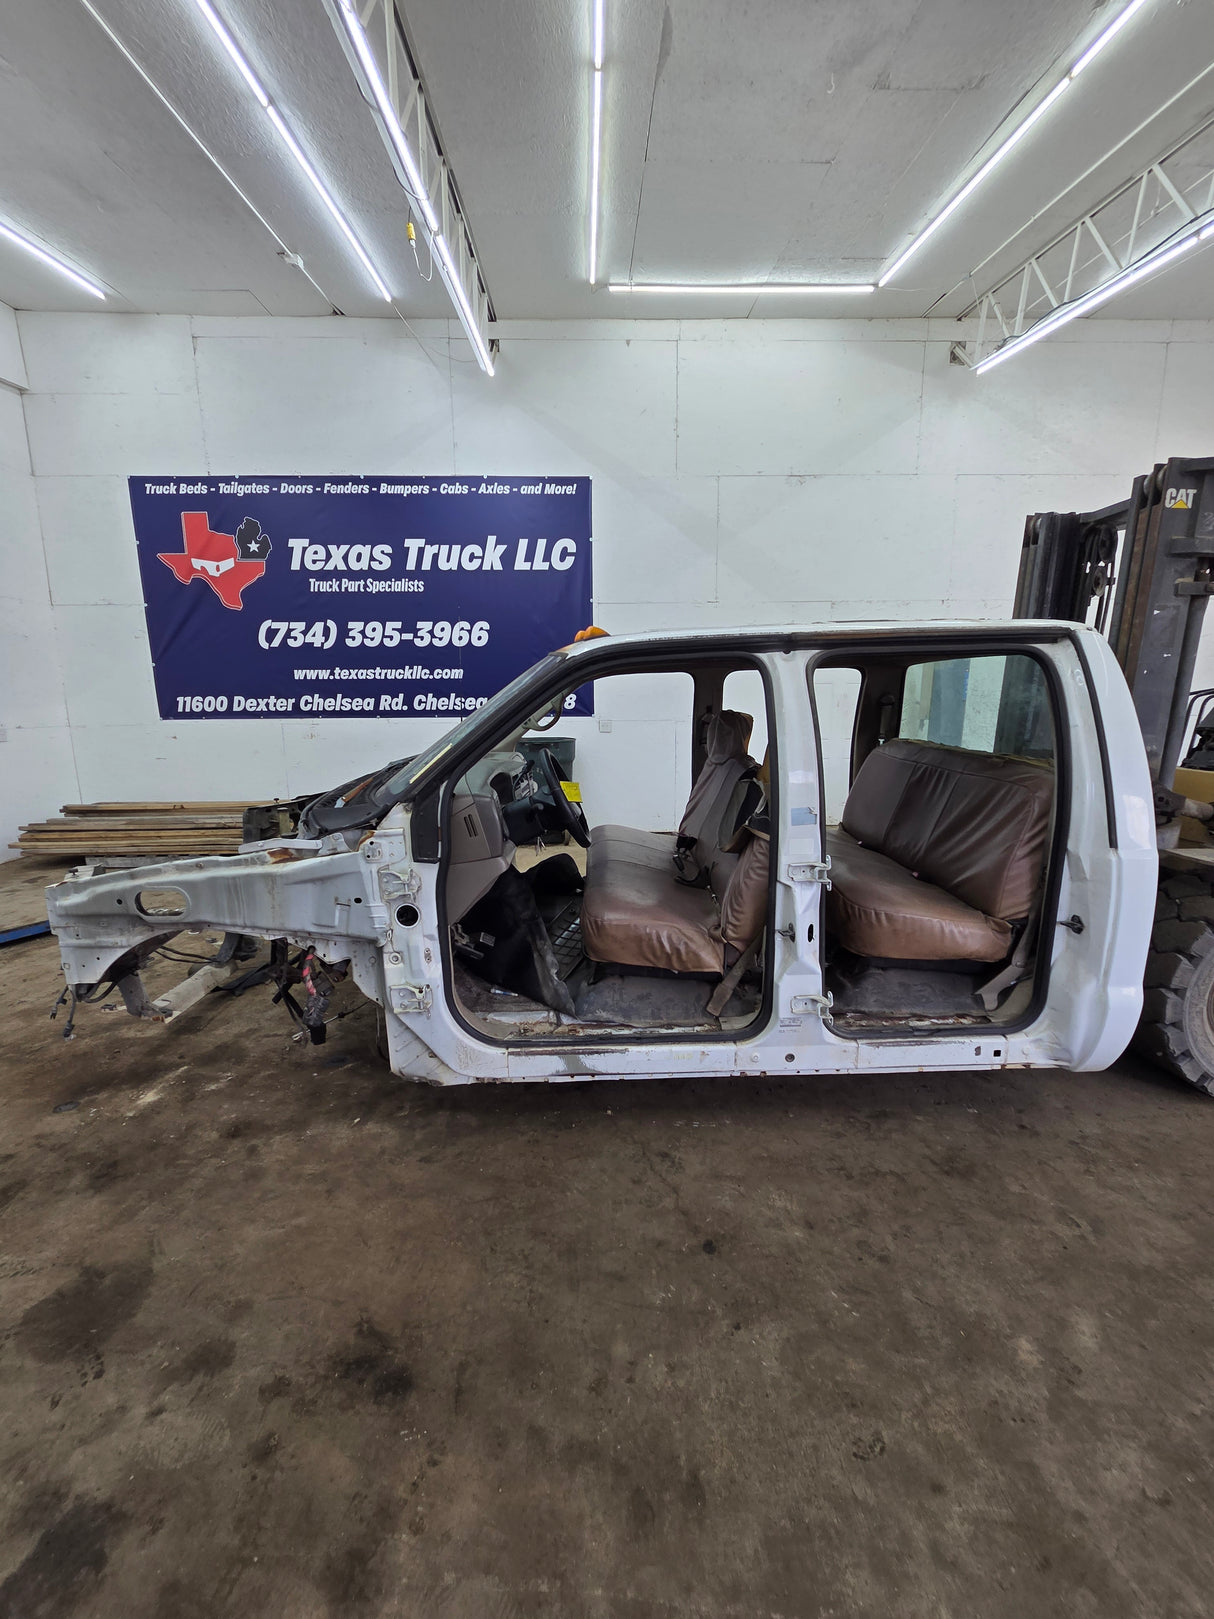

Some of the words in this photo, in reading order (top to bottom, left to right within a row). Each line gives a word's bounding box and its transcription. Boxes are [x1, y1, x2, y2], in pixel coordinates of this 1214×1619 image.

[145, 483, 177, 494] Truck
[179, 483, 207, 494] Beds
[218, 482, 270, 496] Tailgates
[280, 482, 313, 494] Doors
[324, 482, 369, 494] Fenders
[379, 483, 429, 496] Bumpers
[440, 483, 469, 494] Cabs
[478, 482, 510, 494] Axles
[520, 483, 542, 494] and
[544, 483, 577, 495] More!
[1165, 488, 1197, 509] CAT
[288, 538, 393, 571] Texas
[404, 535, 508, 571] Truck
[514, 538, 577, 571] LLC
[309, 579, 340, 592] Truck
[341, 578, 365, 592] Part
[366, 578, 425, 594] Specialists
[258, 619, 338, 650] (734)
[345, 621, 490, 647] 395-3966
[293, 666, 464, 680] www.texastruckllc.com
[176, 696, 228, 712] 11600
[232, 695, 295, 712] Dexter
[299, 694, 375, 711] Chelsea
[379, 694, 408, 711] Rd.
